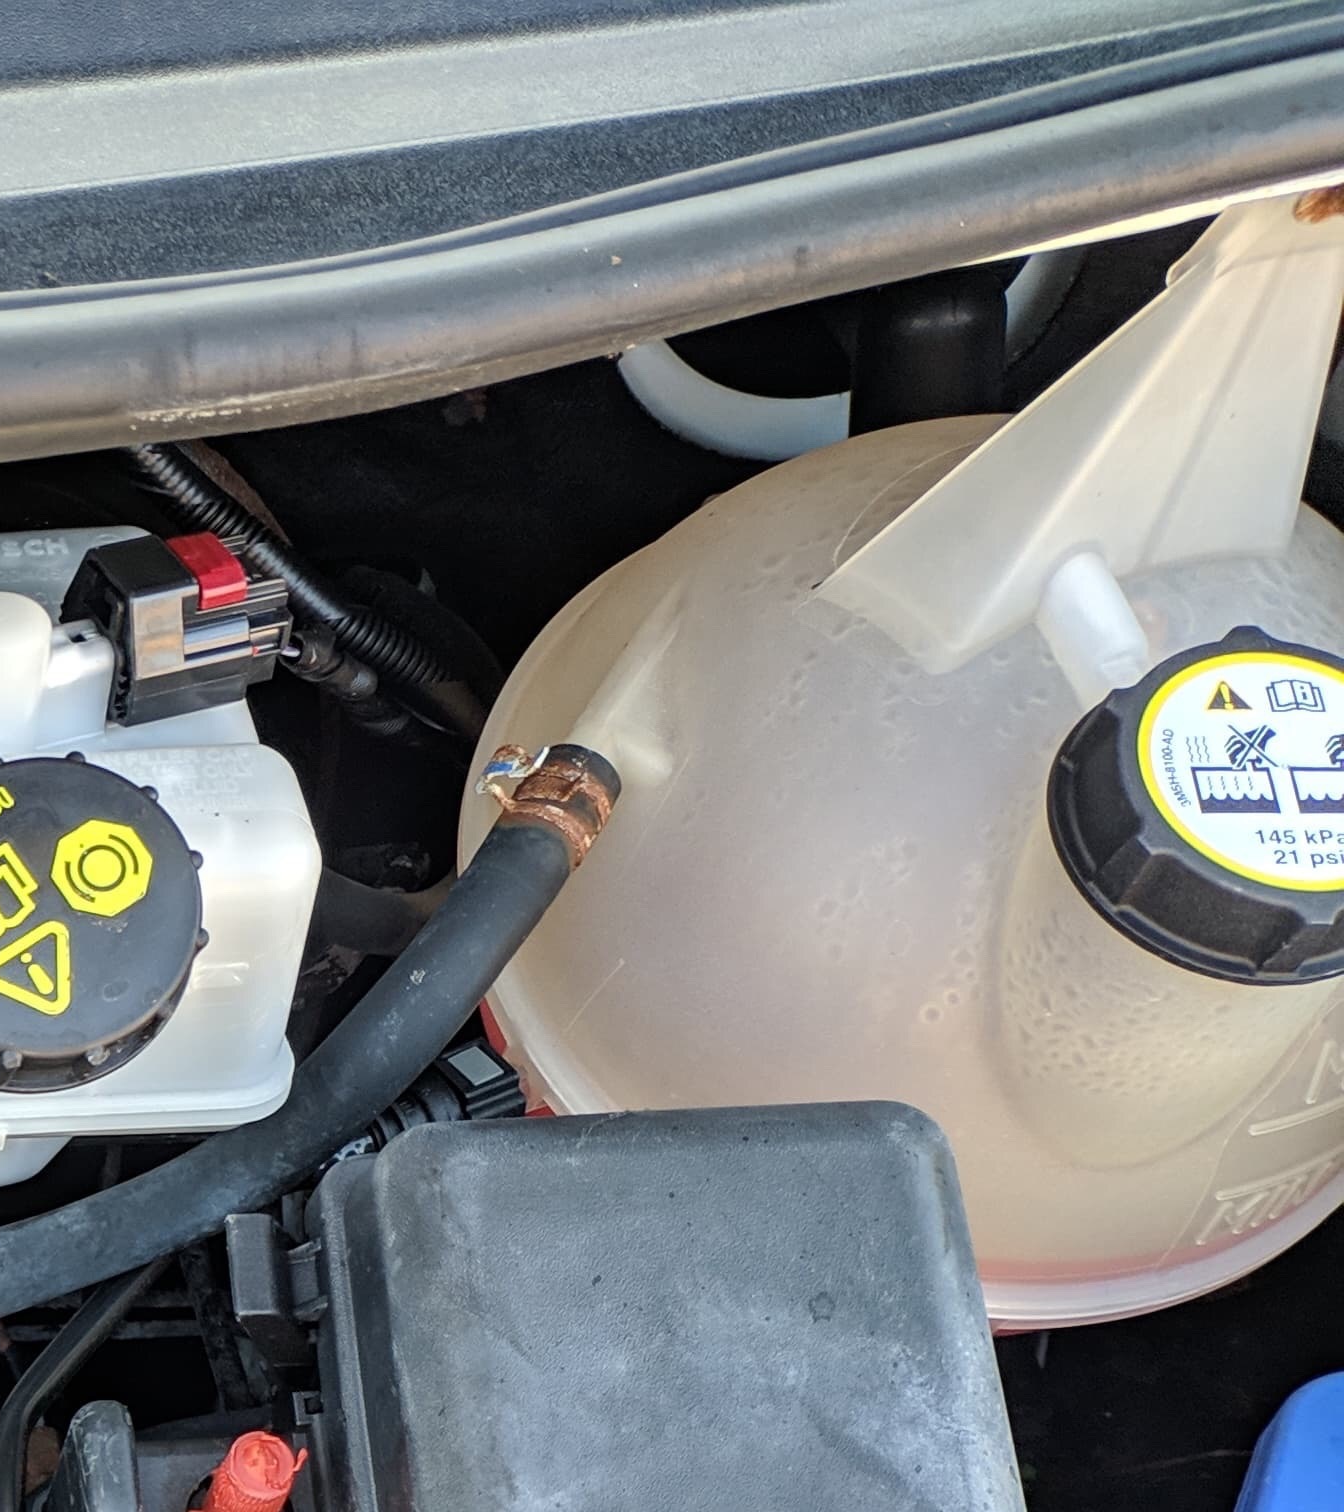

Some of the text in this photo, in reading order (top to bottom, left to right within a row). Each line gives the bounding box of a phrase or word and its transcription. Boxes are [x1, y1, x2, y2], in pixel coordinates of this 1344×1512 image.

[1254, 829, 1344, 845] 145 kPa
[1273, 849, 1344, 868] 21 psi
